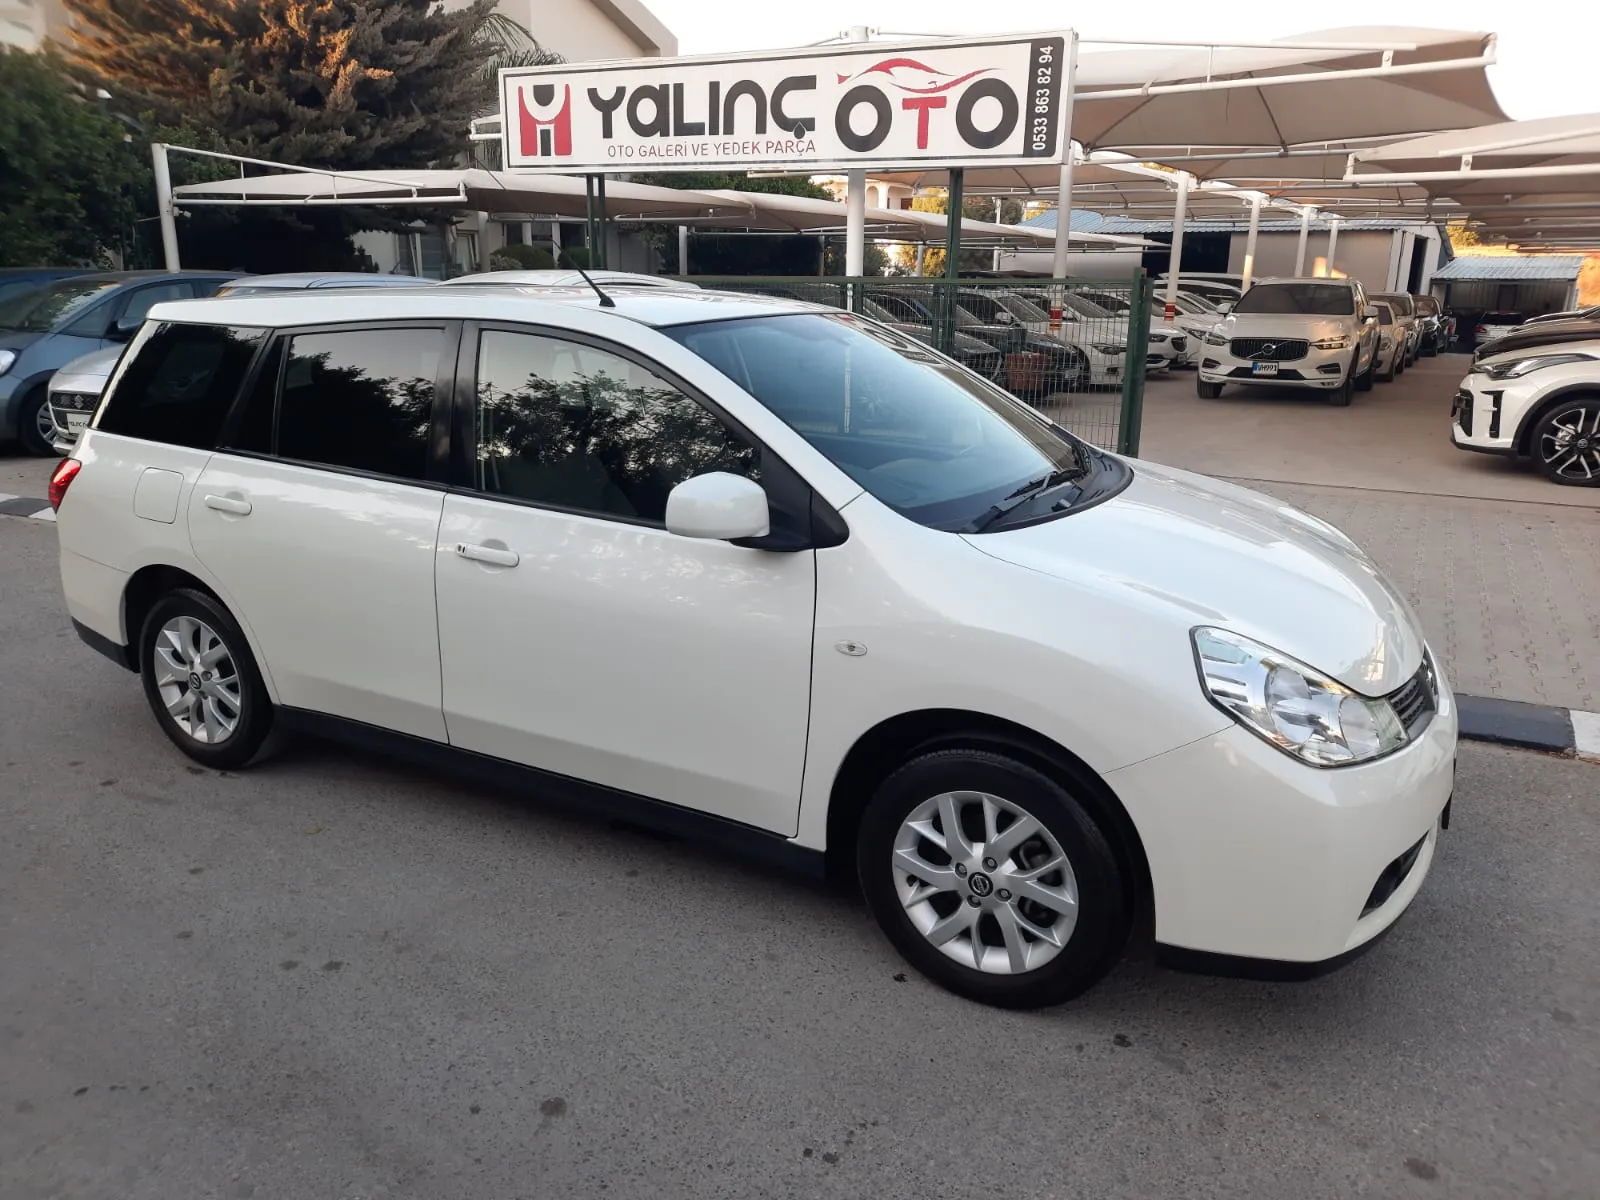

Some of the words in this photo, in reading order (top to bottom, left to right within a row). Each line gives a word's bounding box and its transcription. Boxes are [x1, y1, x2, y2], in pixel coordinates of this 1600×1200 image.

[1038, 45, 1054, 64] 94
[1036, 66, 1052, 85] 82
[1034, 88, 1050, 114] 863
[835, 78, 1019, 152] OTO
[1032, 117, 1048, 151] 0533
[607, 144, 634, 158] OTO
[638, 141, 688, 157] GALERİ
[691, 143, 709, 156] VE
[713, 141, 761, 155] YEDEK
[766, 139, 816, 156] PARÇA
